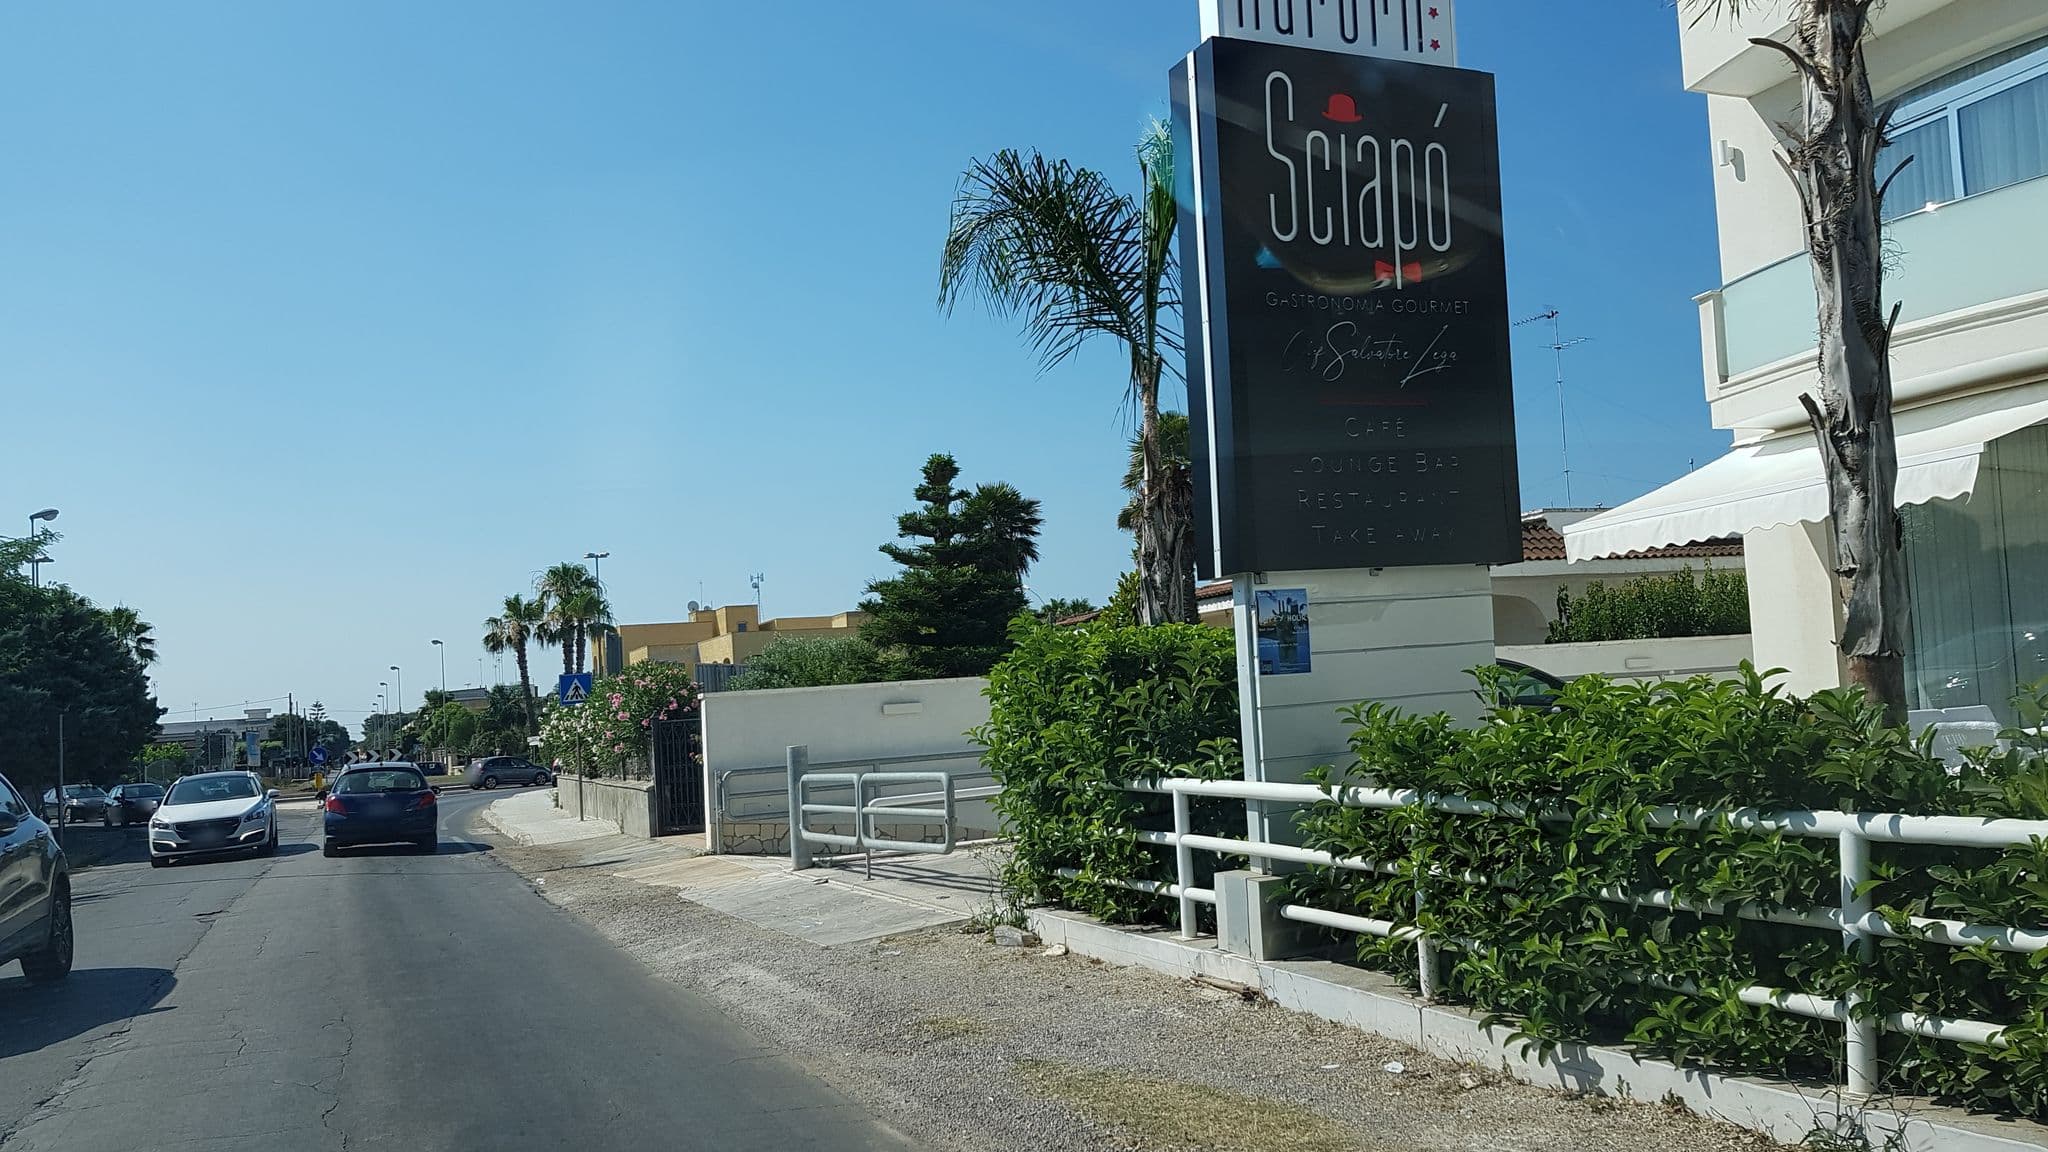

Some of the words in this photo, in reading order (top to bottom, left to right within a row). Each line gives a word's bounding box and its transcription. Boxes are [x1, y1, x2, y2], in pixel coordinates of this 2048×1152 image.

[1265, 291, 1385, 313] GASTRONOMIA
[1391, 299, 1470, 315] GOURMET
[1311, 524, 1377, 544] TAKE
